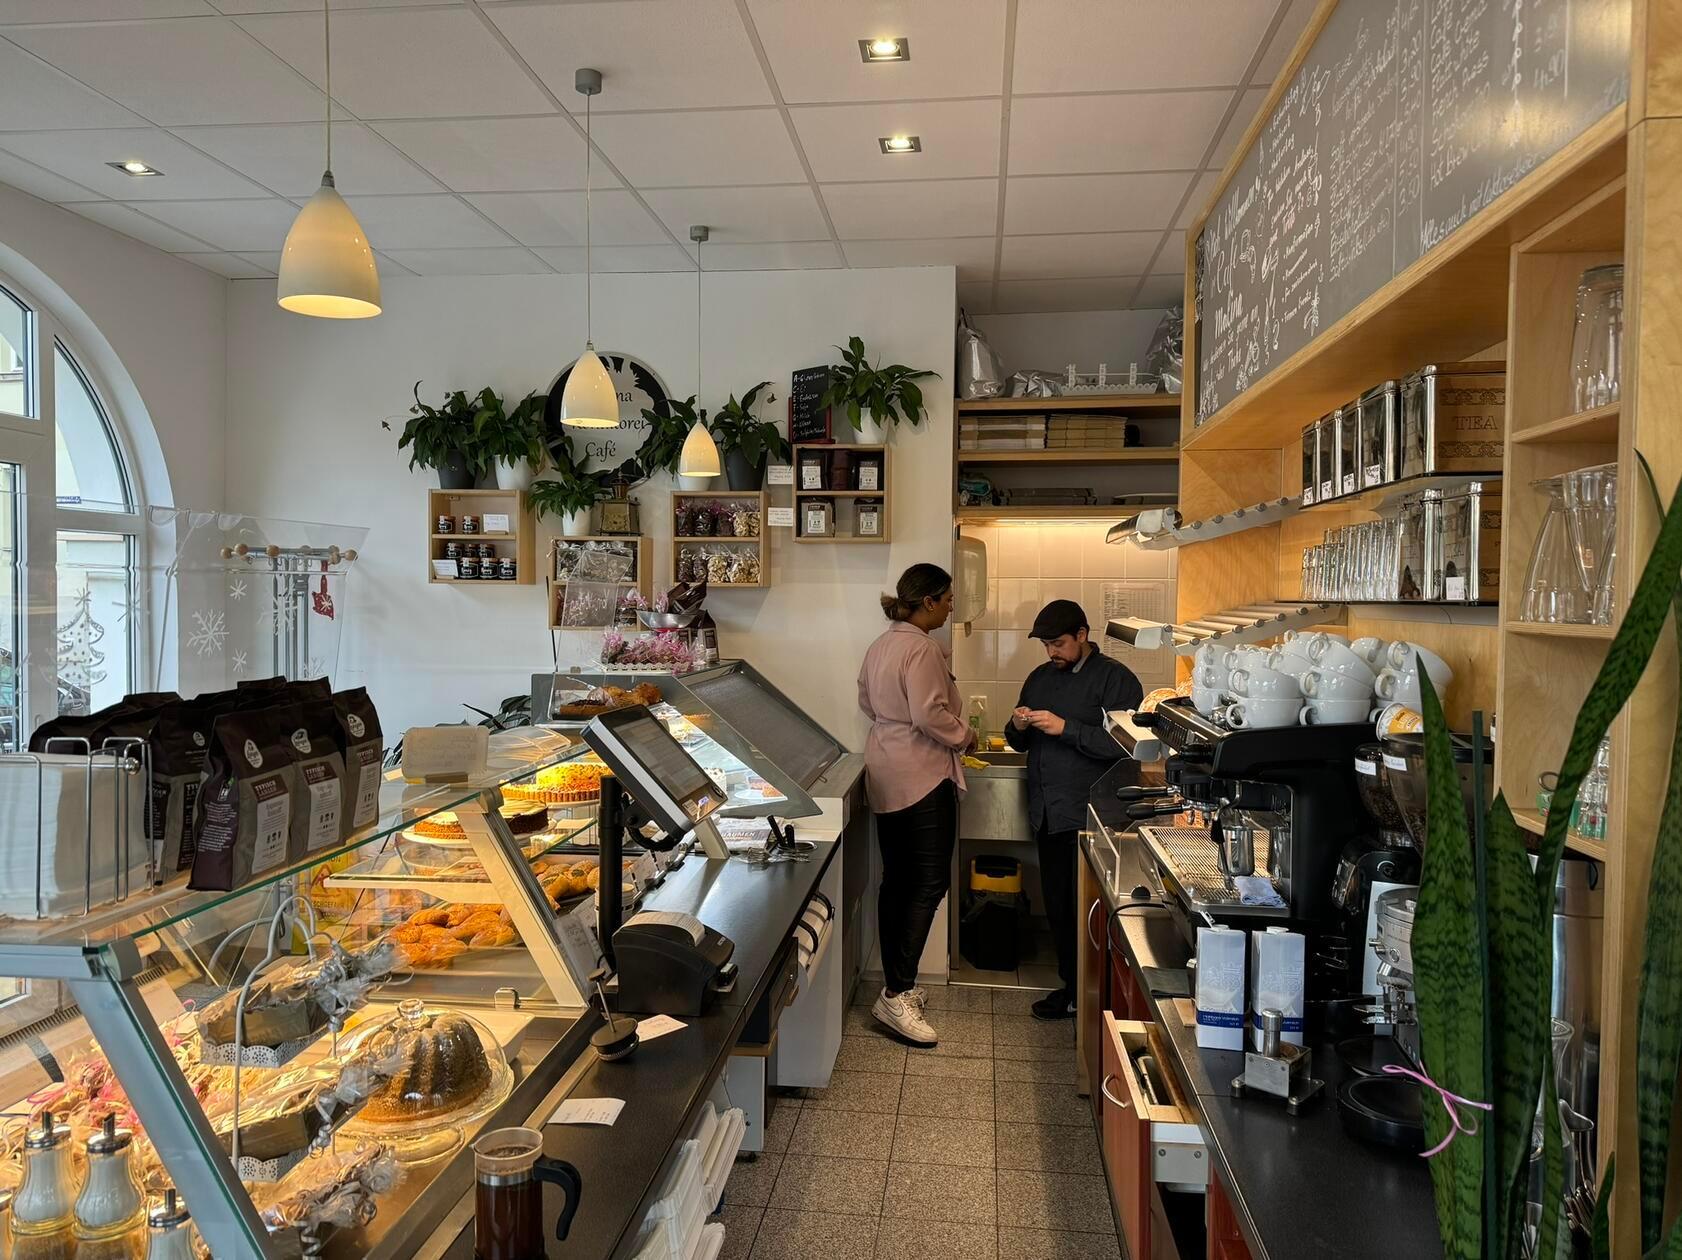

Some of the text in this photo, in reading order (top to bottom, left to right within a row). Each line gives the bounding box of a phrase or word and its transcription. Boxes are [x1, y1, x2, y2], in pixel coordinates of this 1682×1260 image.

[1217, 231, 1238, 296] Café
[1455, 416, 1498, 431] TEA
[585, 440, 616, 462] Café
[255, 780, 276, 790] TYPISCH
